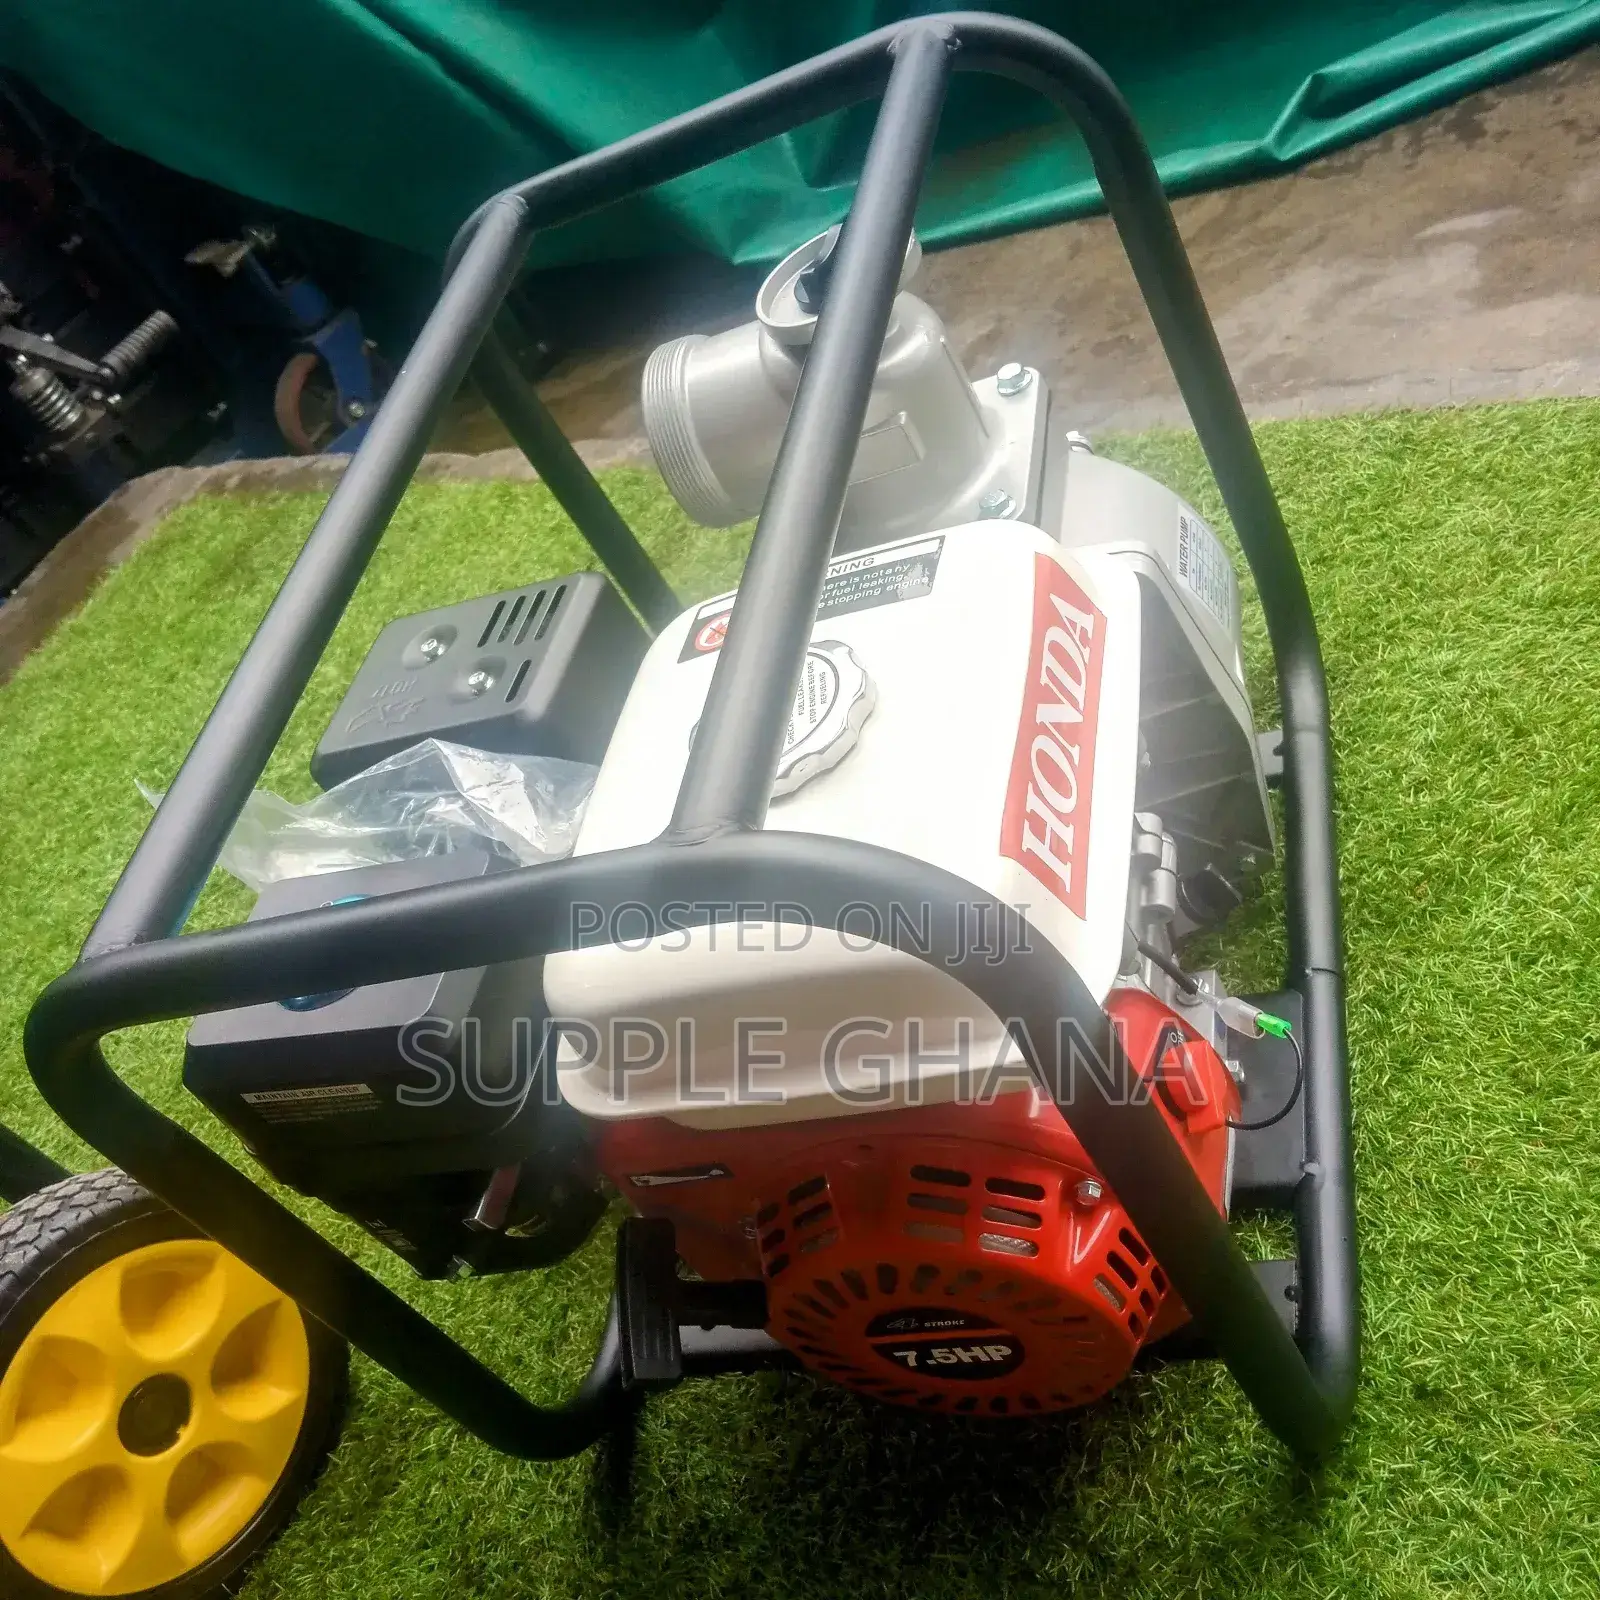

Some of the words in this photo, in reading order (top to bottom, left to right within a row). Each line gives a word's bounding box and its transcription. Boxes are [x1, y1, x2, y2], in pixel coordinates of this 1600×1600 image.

[1179, 516, 1188, 545] PUMP
[830, 557, 875, 576] NING
[1179, 544, 1189, 578] WATER
[849, 575, 860, 584] is
[827, 588, 881, 606] stopping
[886, 576, 929, 591] engine
[832, 585, 855, 597] fuel
[819, 671, 827, 705] REFUELING
[1021, 592, 1096, 894] HONDA
[253, 1090, 299, 1101] MAINTAIN
[301, 1088, 315, 1097] AIR
[317, 1085, 359, 1096] CLEANER
[924, 1319, 965, 1328] STROKE
[893, 1345, 1012, 1367] 7.5HP
